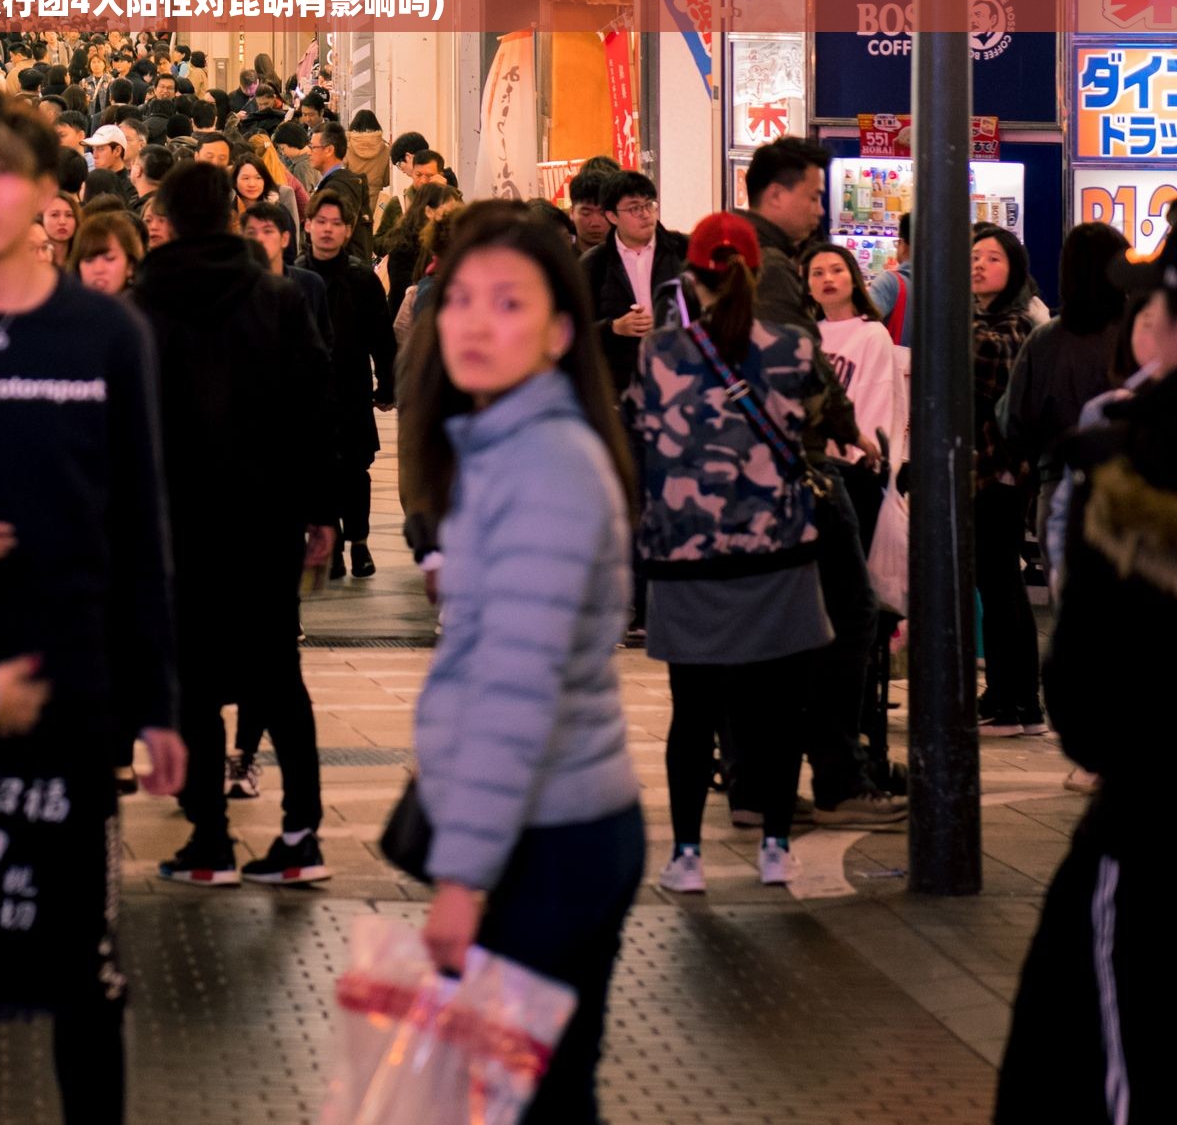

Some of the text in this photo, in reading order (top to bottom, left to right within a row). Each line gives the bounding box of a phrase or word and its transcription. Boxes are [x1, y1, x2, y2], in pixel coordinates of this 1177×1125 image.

[857, 3, 914, 36] BO
[868, 40, 913, 56] COFF
[1082, 53, 1177, 110] ダイ
[866, 132, 889, 146] 551
[862, 146, 892, 154] HORAI
